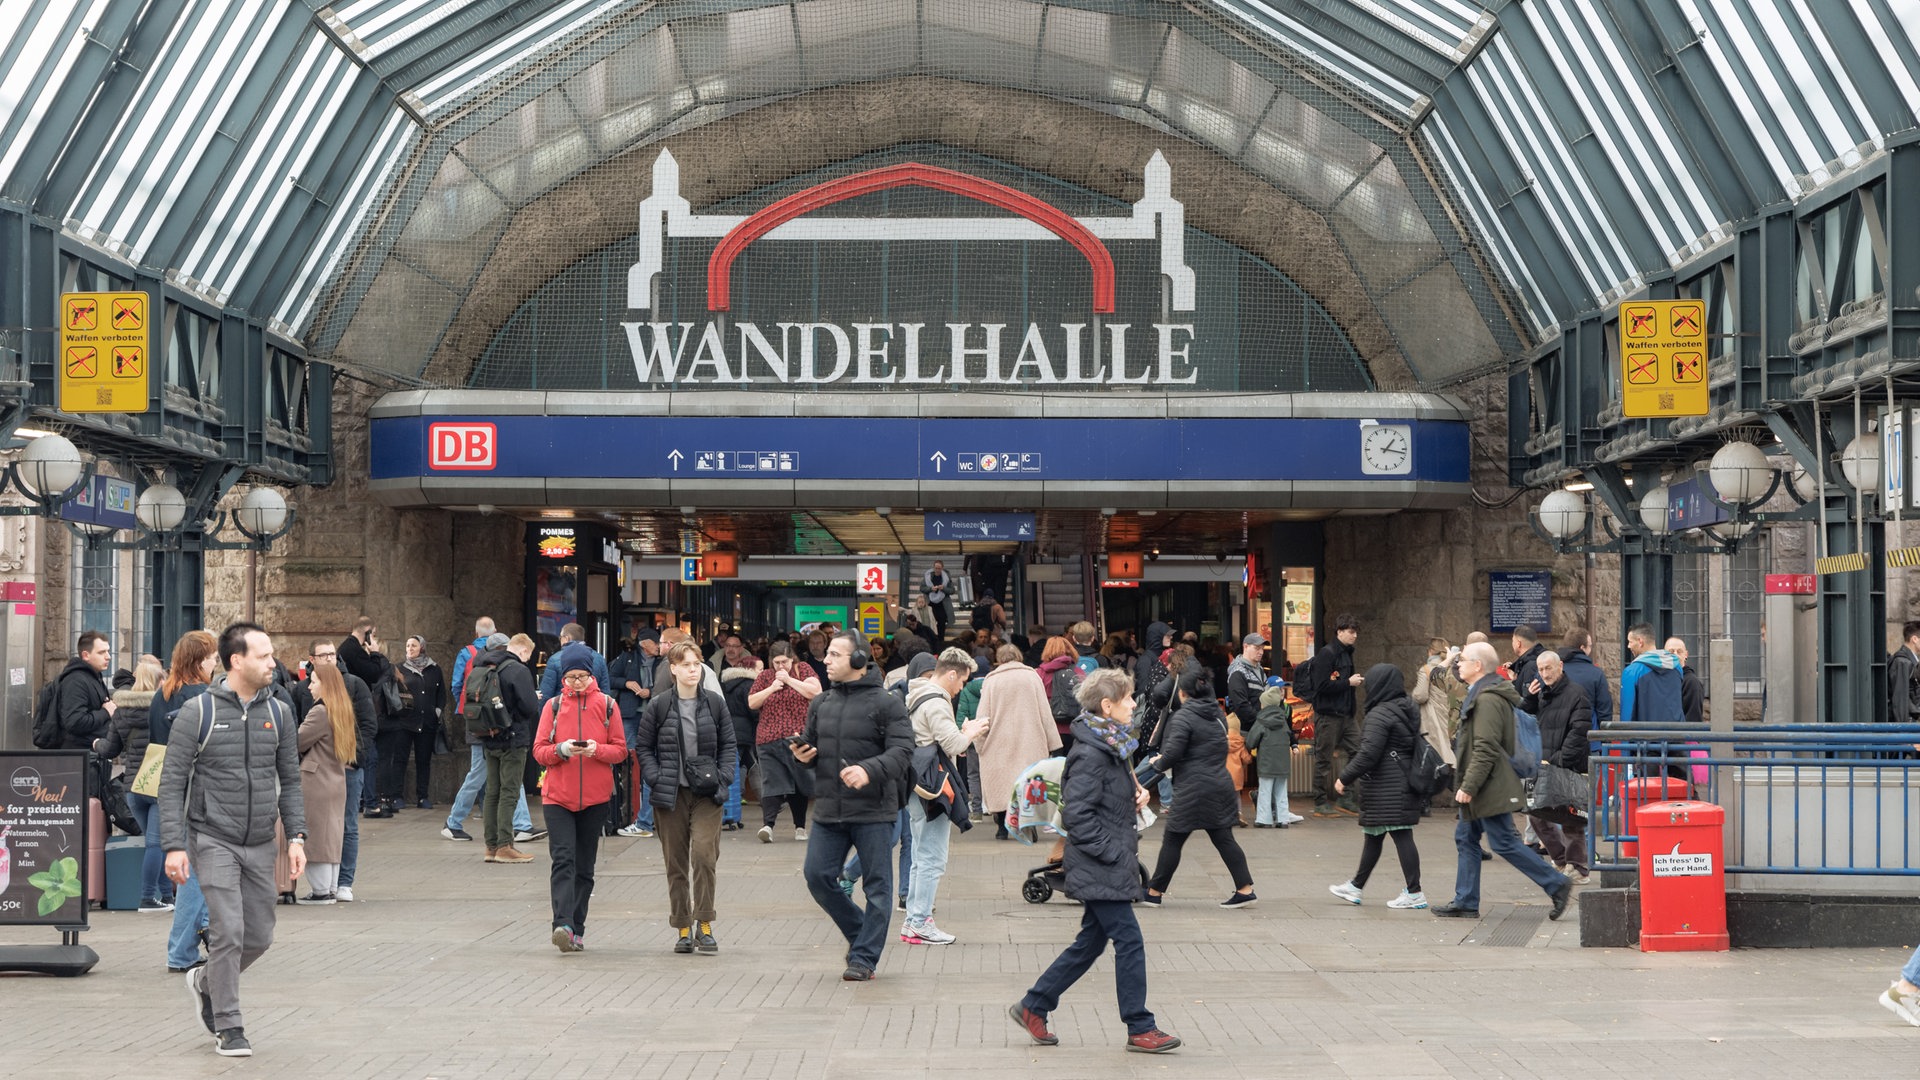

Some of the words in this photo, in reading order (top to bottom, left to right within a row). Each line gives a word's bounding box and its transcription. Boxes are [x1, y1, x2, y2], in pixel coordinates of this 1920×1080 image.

[66, 334, 98, 342] Waffen
[101, 334, 143, 342] verboten
[1626, 341, 1659, 349] Waffen
[1661, 340, 1702, 348] verboten
[619, 322, 1198, 385] WANDELHALLE
[438, 431, 489, 462] DB
[1021, 454, 1031, 462] IC
[959, 462, 974, 470] WC
[540, 528, 574, 536] POMMES
[546, 547, 562, 555] 2,90
[864, 617, 880, 634] E
[31, 785, 68, 803] Neu!
[7, 804, 24, 814] for
[27, 804, 80, 817] president
[27, 818, 75, 827] hausgemacht
